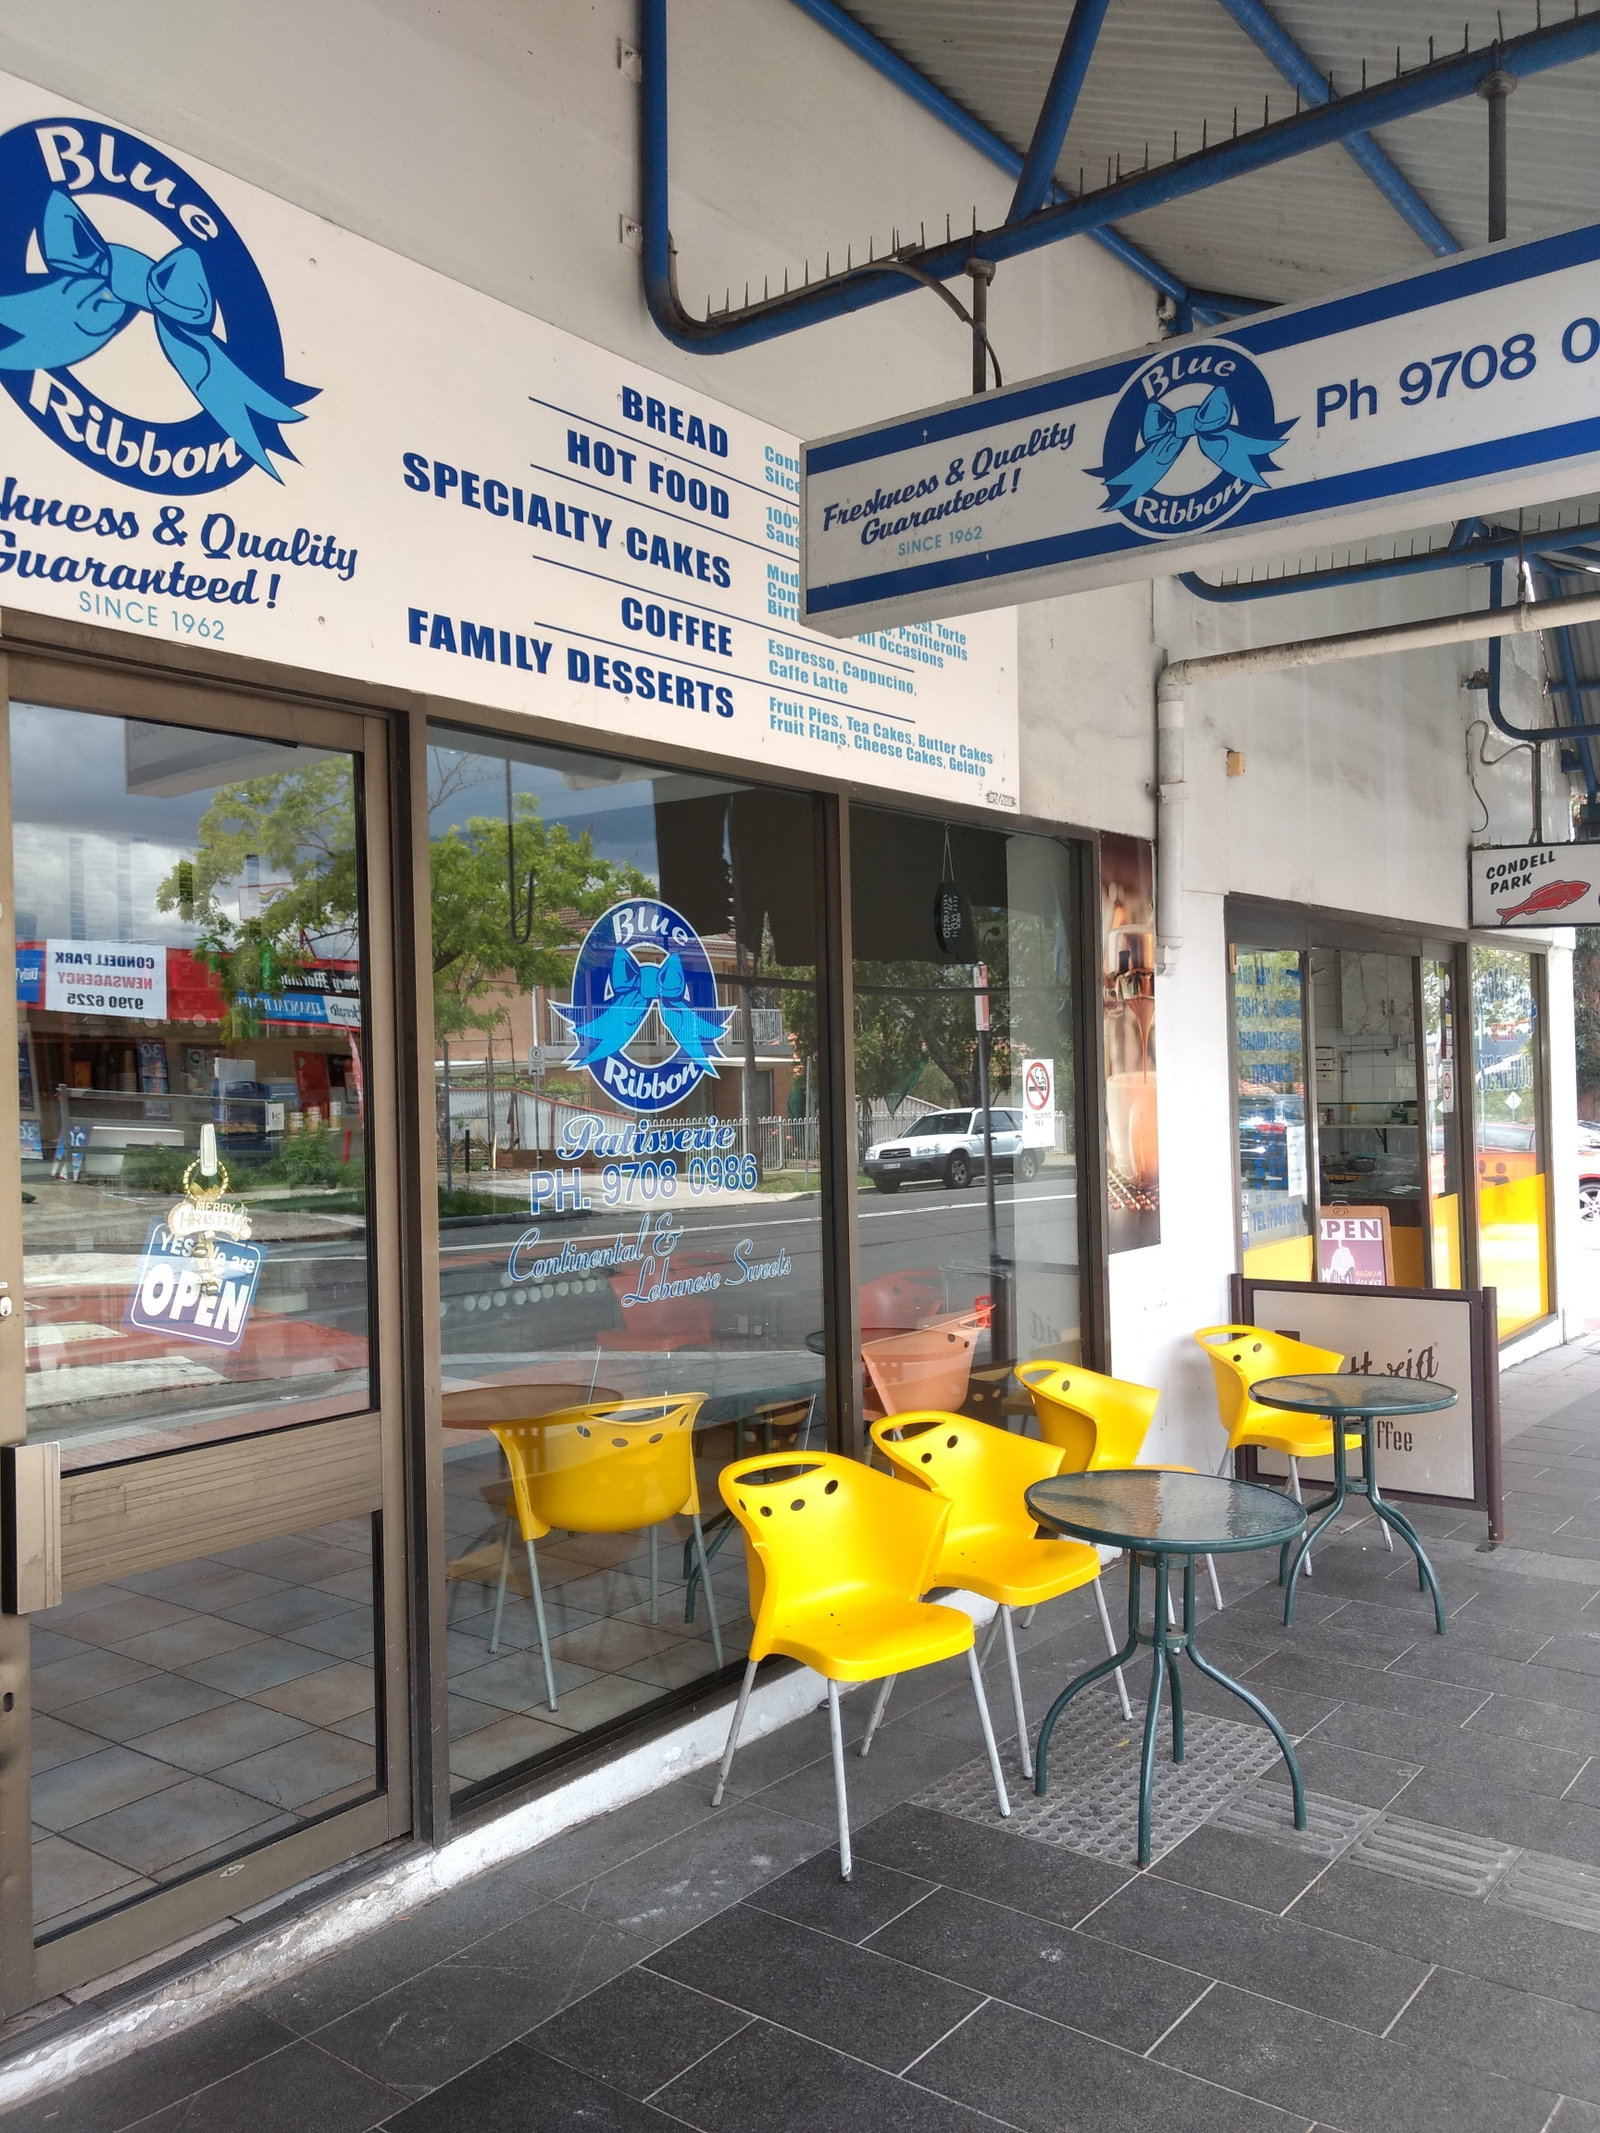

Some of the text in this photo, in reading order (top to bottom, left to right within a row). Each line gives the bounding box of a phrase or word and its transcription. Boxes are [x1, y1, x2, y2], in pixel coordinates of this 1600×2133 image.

[35, 125, 219, 242] Blue
[1142, 354, 1237, 400] Blue
[1316, 378, 1378, 428] Ph
[1399, 333, 1537, 406] 9708
[29, 369, 243, 478] Ribbon
[621, 385, 729, 458] BREAD
[567, 429, 729, 520] HOT FOOD
[764, 446, 800, 474] Cont
[765, 466, 800, 494] Slice
[823, 421, 1077, 531] Freshness & Quality
[402, 452, 731, 589] SPECIALTY CAKES
[1133, 476, 1246, 526] Ribbon
[0, 476, 358, 581] hness & Quality
[766, 524, 800, 549] Saus
[898, 526, 983, 557] SINCE 1962
[79, 591, 226, 641] SINCE 1962
[621, 597, 733, 658] COFFEE
[937, 623, 966, 645] Torte
[408, 607, 734, 720] FAMILY DESSERTS
[768, 639, 917, 696] Espresso, Cappucino,
[879, 636, 944, 668] Occasions
[899, 626, 967, 661] Profiterolls
[769, 660, 848, 695] Caffe Latte
[769, 697, 993, 764] Fruit Pies, Tea Cakes, Butter Cakes
[770, 715, 986, 777] Fruit Flans, Cheese Cakes, Gelato
[1486, 850, 1556, 880] CONDELL
[1490, 872, 1532, 895] PARK
[612, 910, 689, 947] Blue
[603, 1056, 699, 1100] Ribbon
[557, 1115, 735, 1160] Patisserie
[530, 1154, 757, 1215] PH. 9708 0986
[508, 1212, 683, 1282] Continental &
[1321, 1221, 1379, 1238] PEN
[232, 1255, 255, 1274] are
[621, 1239, 792, 1307] Lebanese Sweets
[142, 1263, 249, 1333] OPEN
[1377, 1420, 1412, 1452] ffee
